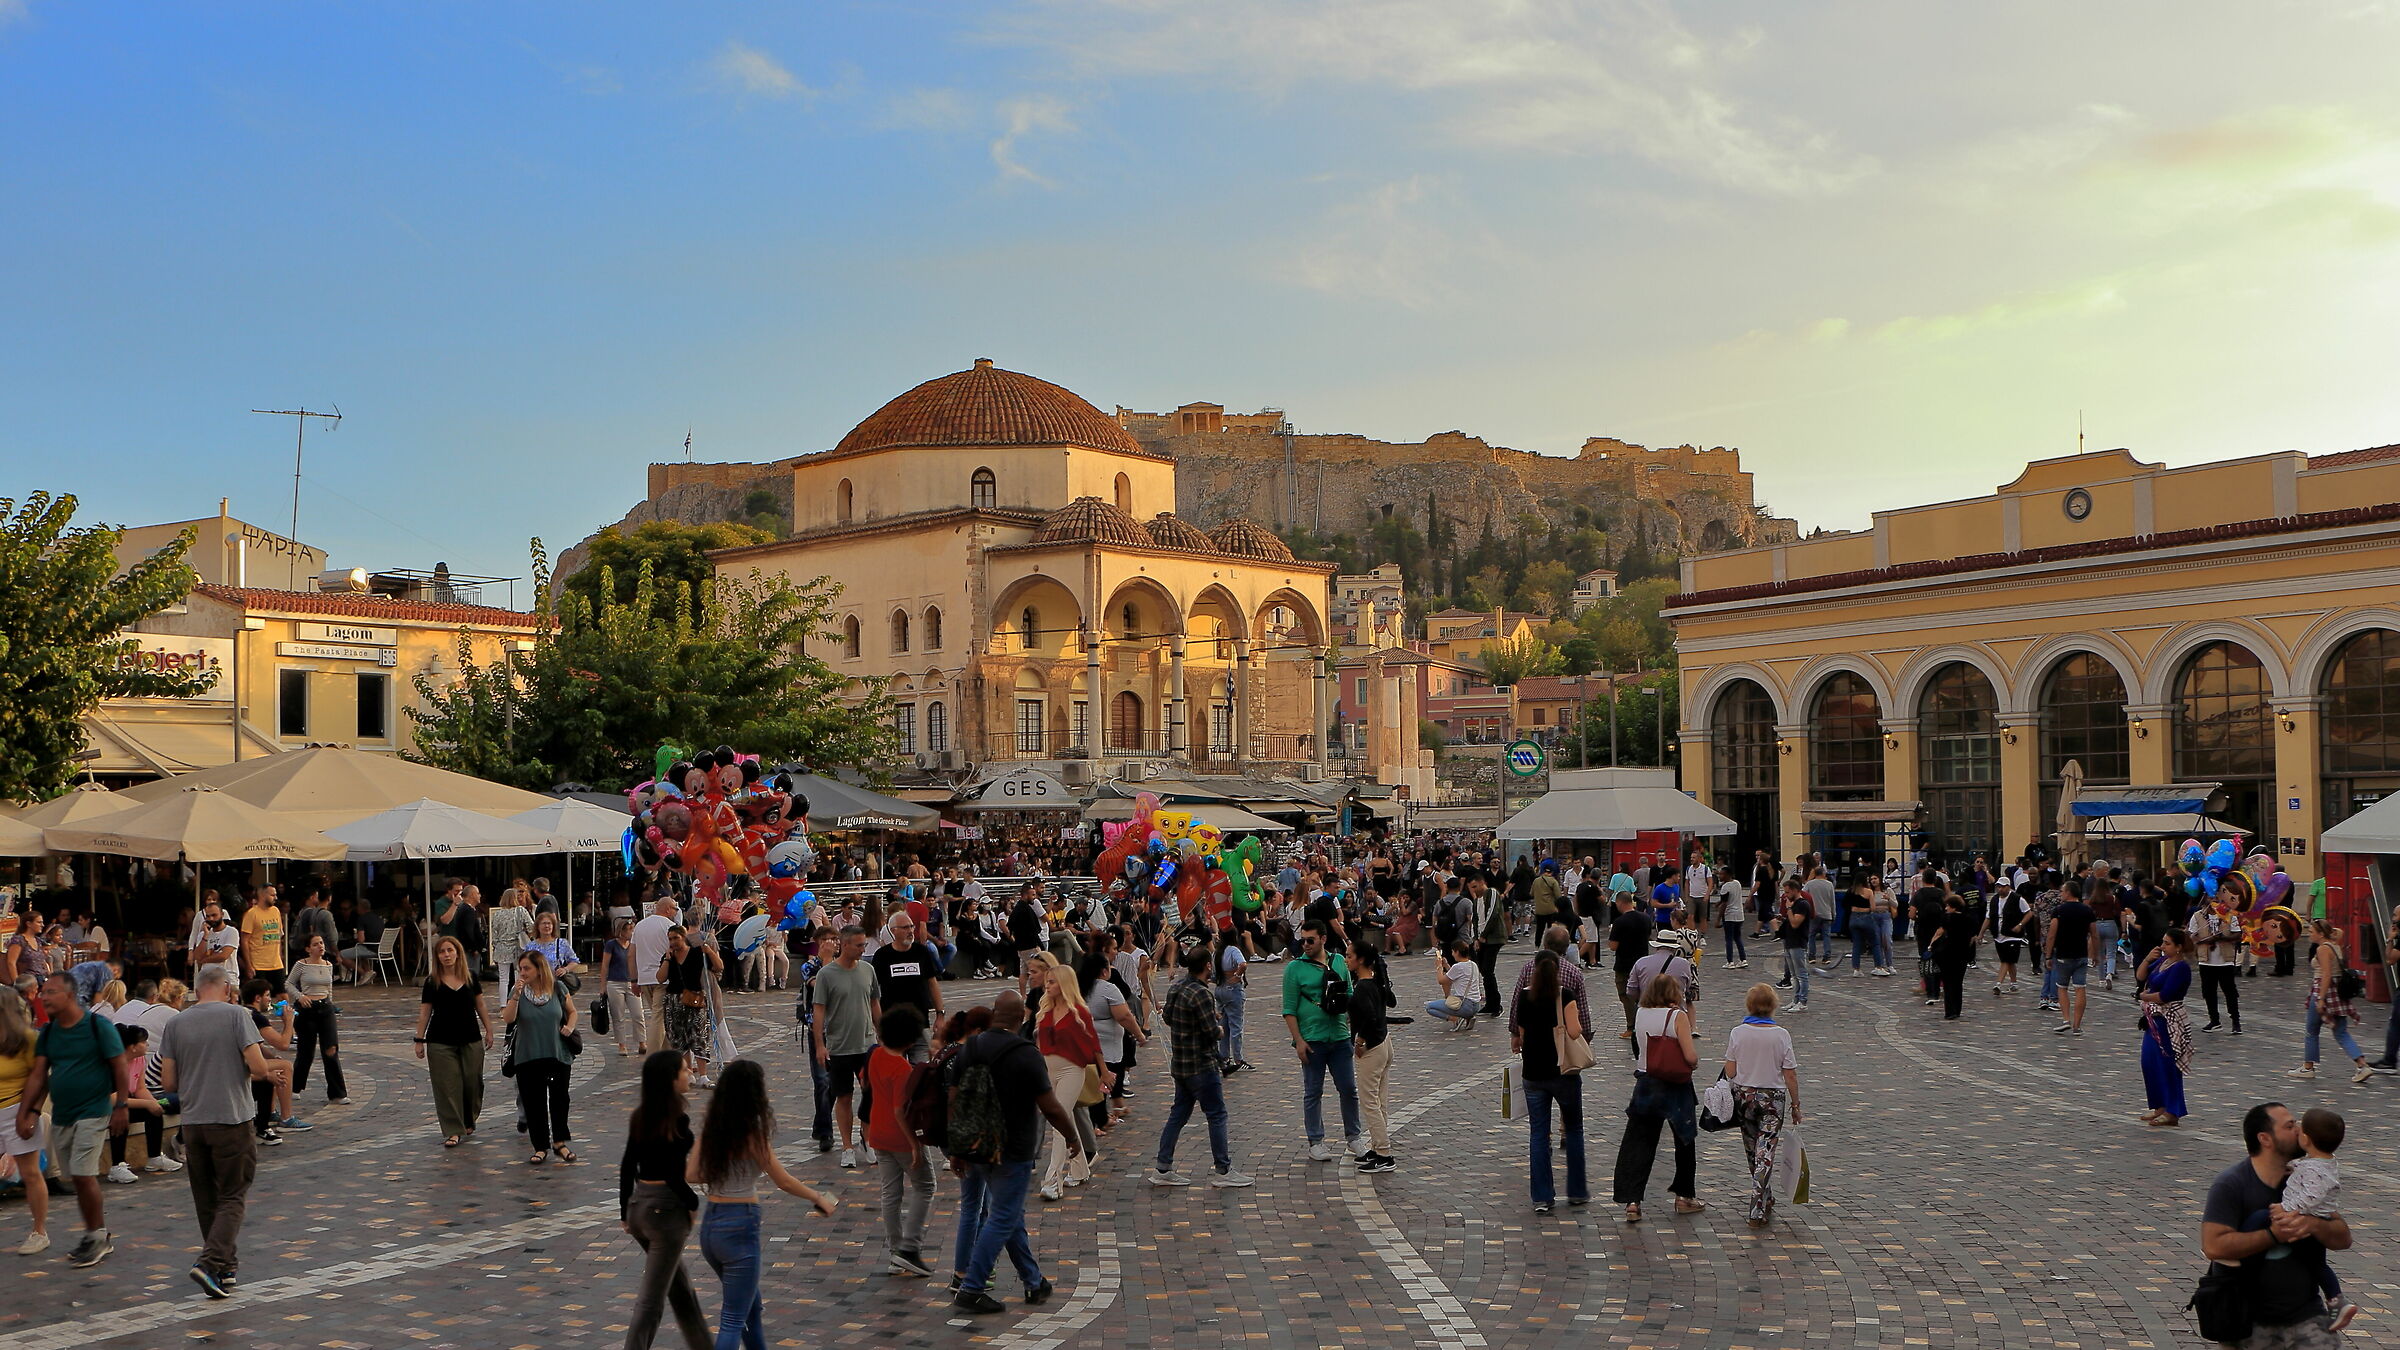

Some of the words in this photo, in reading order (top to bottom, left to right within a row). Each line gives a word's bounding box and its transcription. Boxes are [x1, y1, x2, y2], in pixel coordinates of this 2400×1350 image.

[325, 625, 373, 640] Lagom
[294, 646, 311, 654] The
[314, 647, 340, 655] Pasta
[344, 649, 368, 657] Place
[1003, 780, 1047, 796] GES
[836, 816, 866, 827] Lagom
[867, 816, 878, 824] The
[878, 817, 895, 825] Greek
[895, 818, 909, 826] Place
[577, 838, 599, 847] ΑΛΦΑ
[427, 844, 452, 853] ΑΛΦΑ
